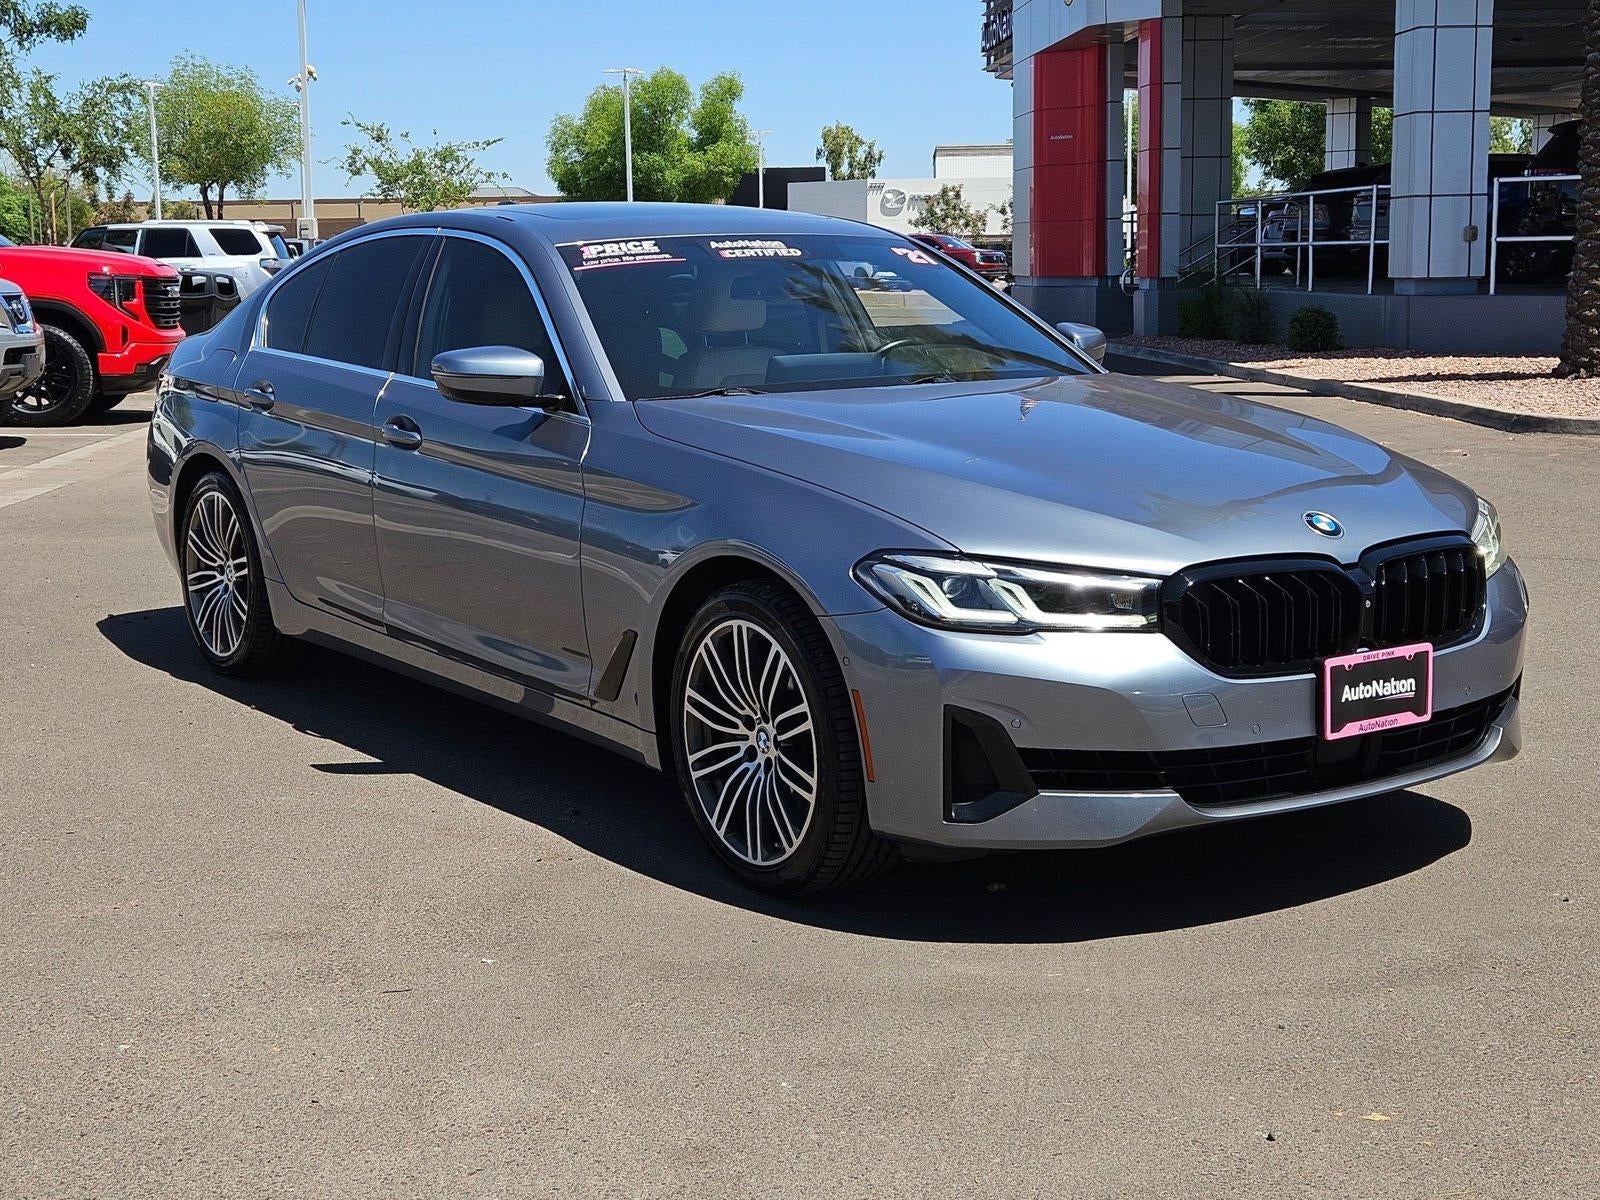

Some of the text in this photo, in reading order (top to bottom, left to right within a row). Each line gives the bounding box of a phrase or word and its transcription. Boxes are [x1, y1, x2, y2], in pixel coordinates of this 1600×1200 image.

[709, 240, 786, 248] AutoNation
[726, 248, 802, 258] CERTIFIED
[1362, 650, 1396, 661] DRIVE PINK
[1341, 677, 1416, 703] AutoNation
[1358, 719, 1398, 732] AutoNation
